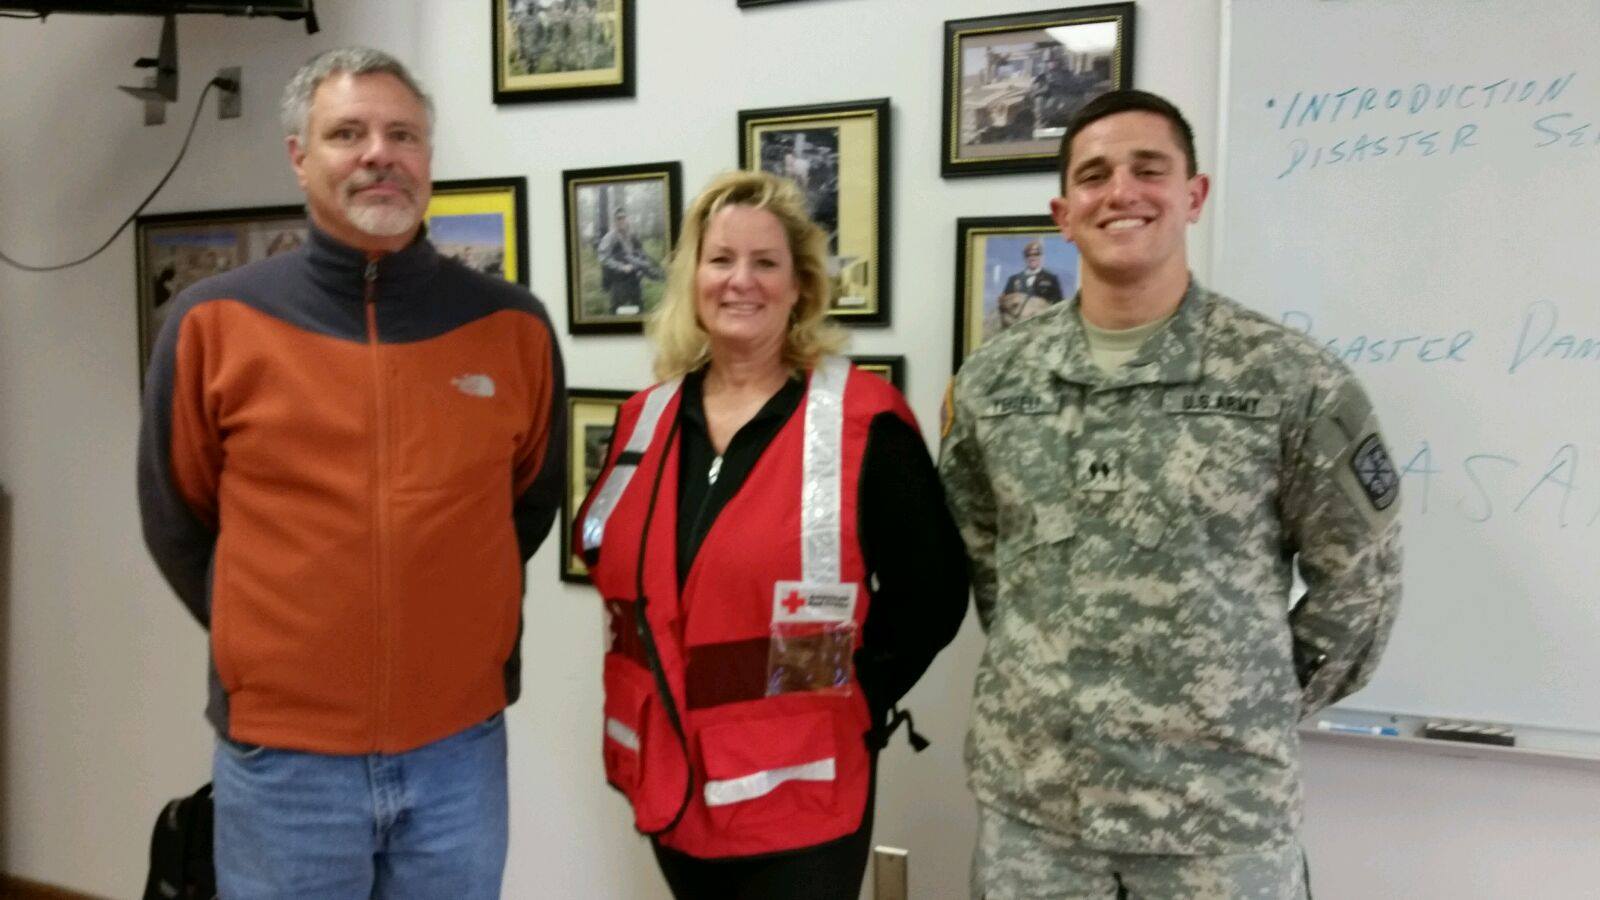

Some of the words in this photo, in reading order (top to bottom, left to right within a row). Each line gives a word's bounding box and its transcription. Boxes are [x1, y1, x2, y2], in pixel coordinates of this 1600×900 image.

[1279, 72, 1576, 130] INTRODUCTION
[1277, 123, 1479, 180] DISASTER
[1533, 111, 1600, 149] SE
